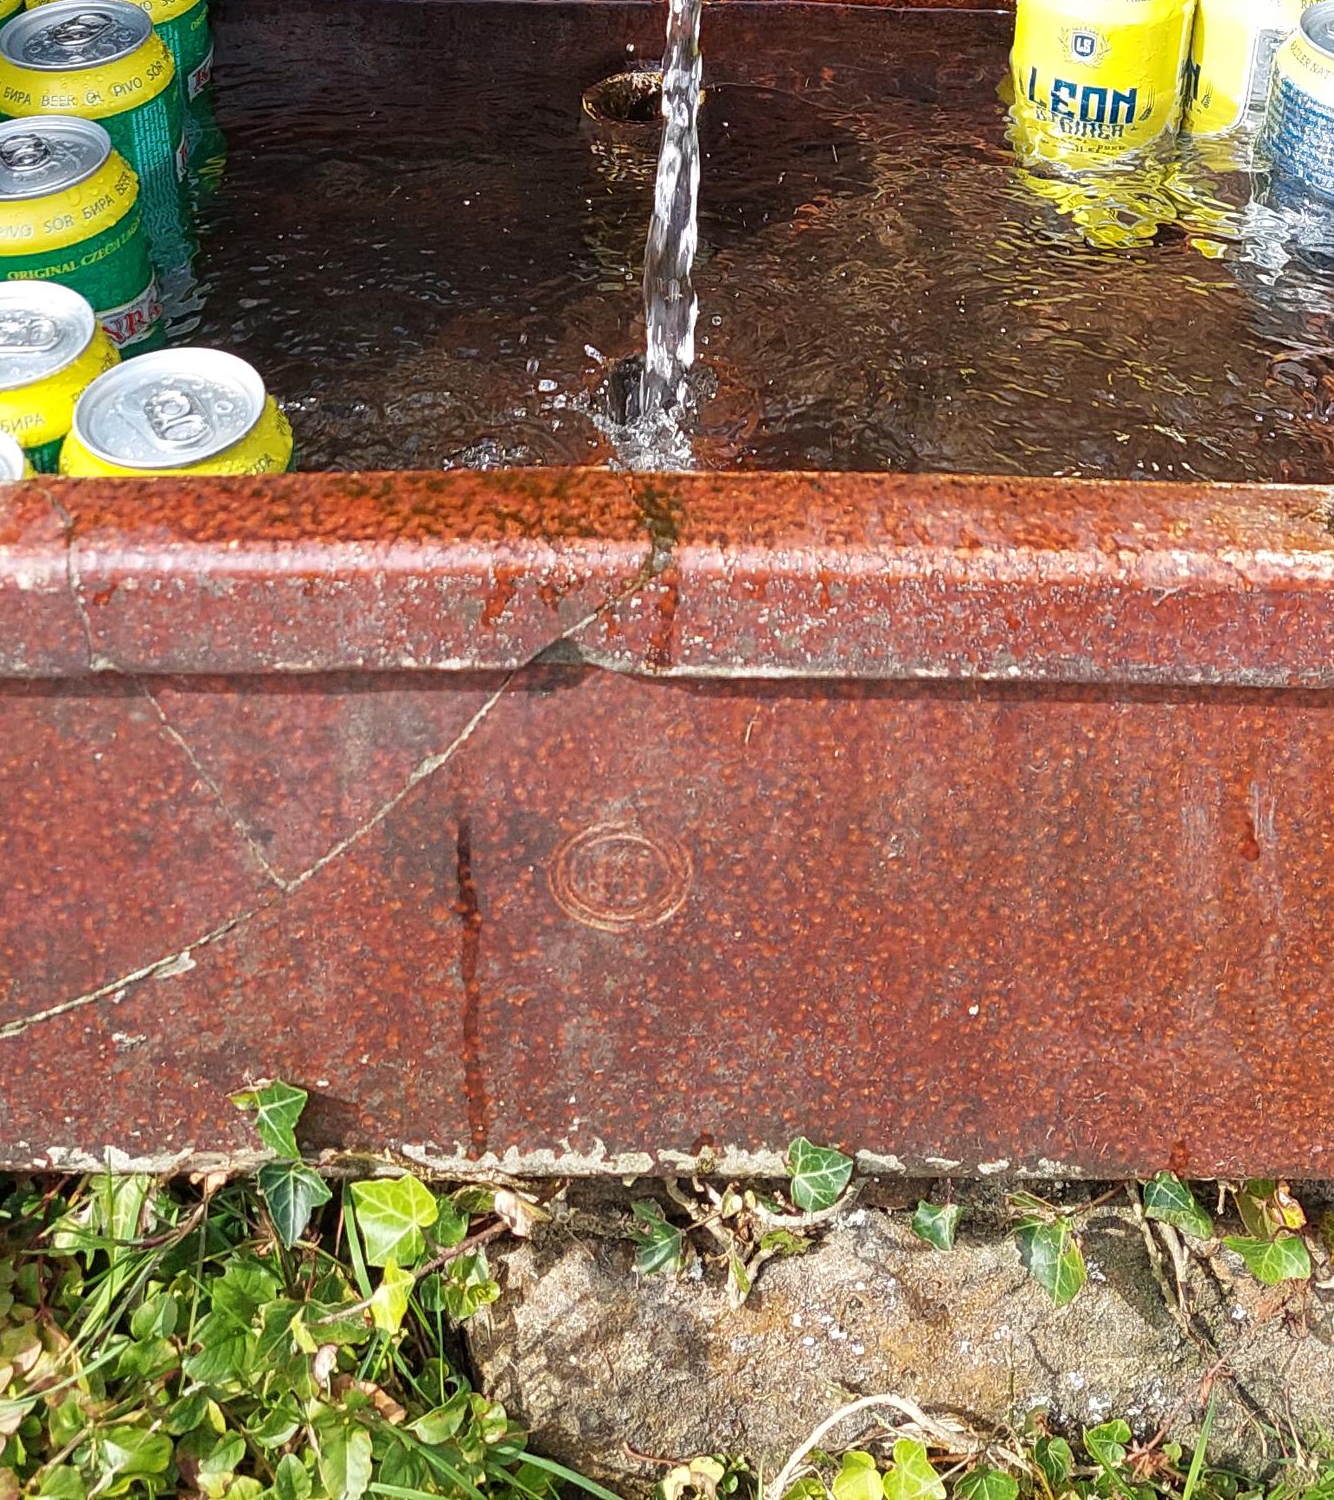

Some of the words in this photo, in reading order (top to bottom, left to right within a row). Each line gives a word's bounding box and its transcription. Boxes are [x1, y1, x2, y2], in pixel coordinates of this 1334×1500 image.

[3, 85, 32, 106] БИРА
[41, 93, 78, 108] BEER
[113, 76, 143, 99] PIVO
[1028, 65, 1138, 125] LEON
[81, 193, 116, 221] БИРА
[0, 411, 47, 434] БИРА
